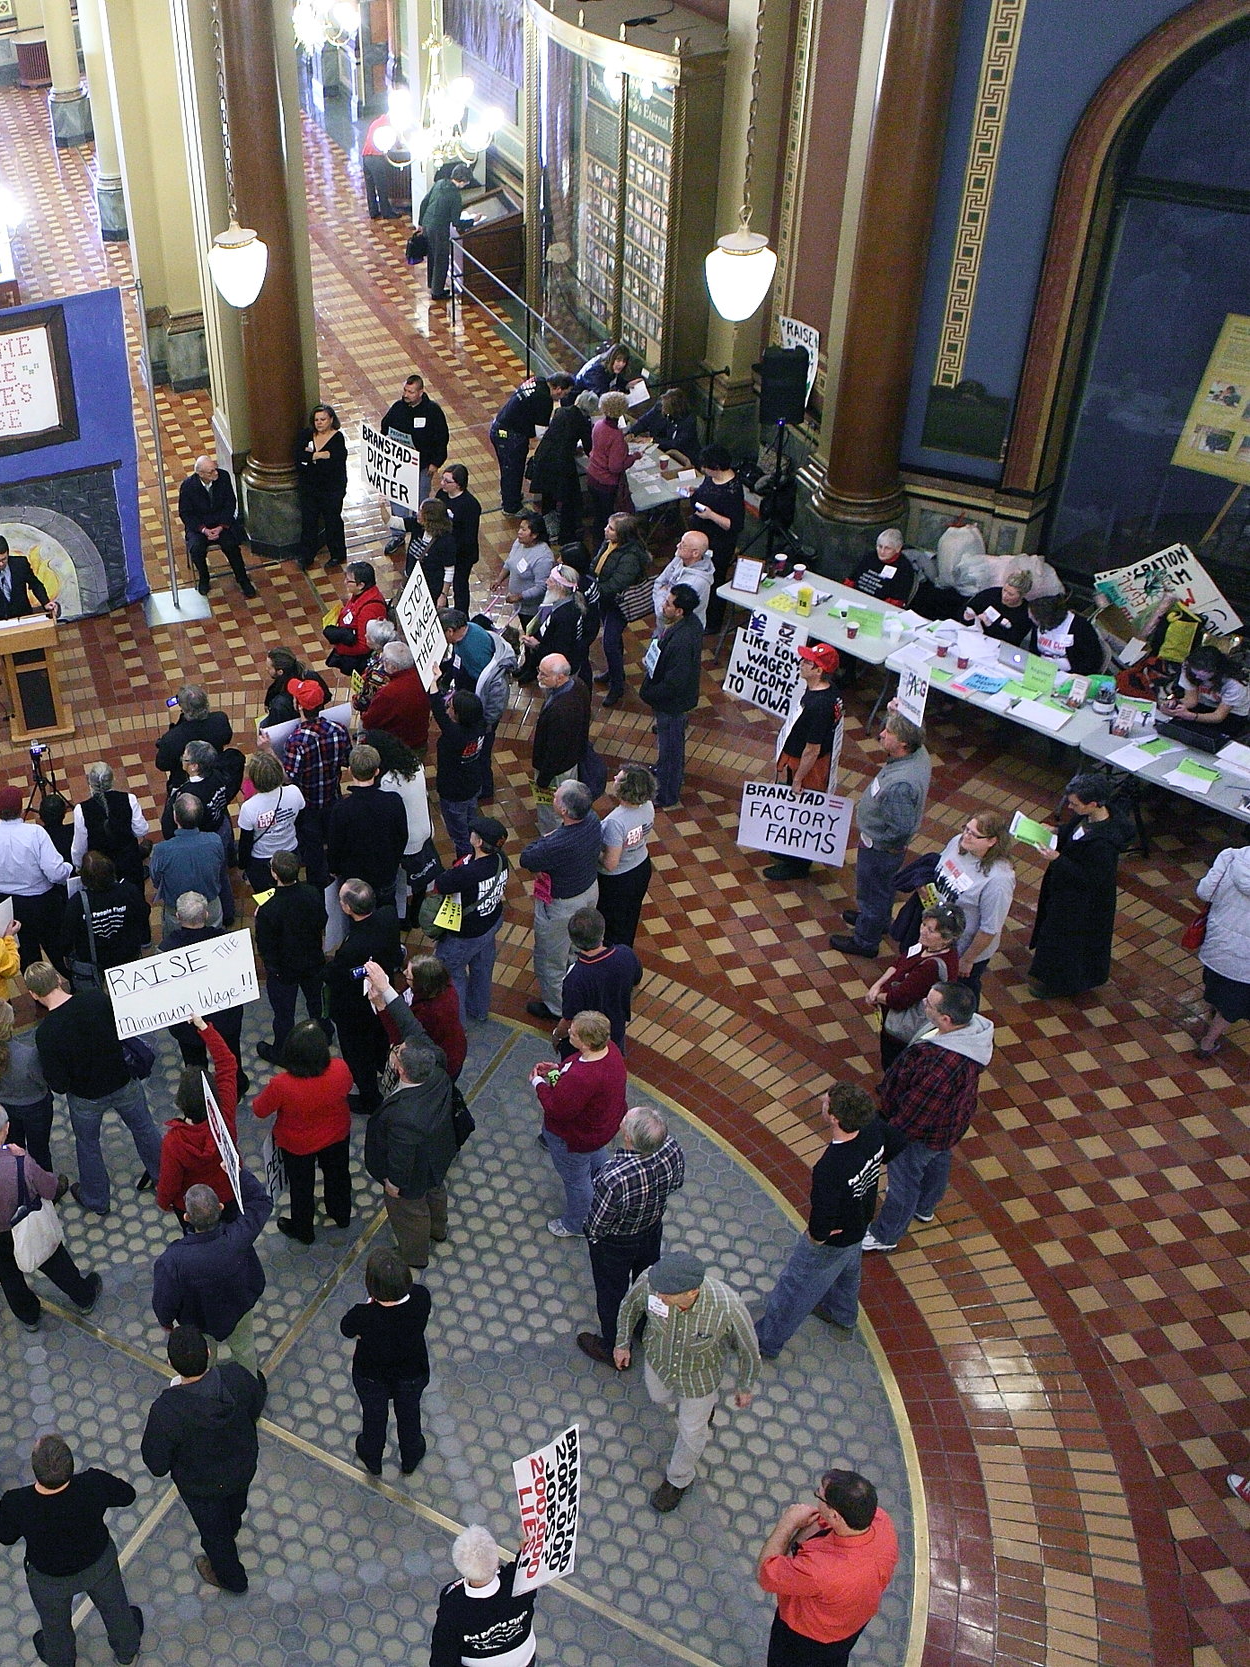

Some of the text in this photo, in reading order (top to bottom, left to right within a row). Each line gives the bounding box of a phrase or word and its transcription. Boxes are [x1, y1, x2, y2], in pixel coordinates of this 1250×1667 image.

[786, 321, 814, 348] RAISE
[367, 446, 402, 478] DIRTY
[365, 465, 409, 504] WATER
[403, 574, 423, 626] STOP
[410, 597, 434, 645] WAGE
[416, 615, 440, 671] THEFT
[742, 631, 804, 666] LIKE LOW
[729, 674, 790, 716] TO IOWA
[736, 660, 794, 699] WELCOME
[746, 784, 825, 806] BRANSTAD
[750, 801, 840, 831] FACTORY
[766, 823, 836, 854] FARMS
[108, 949, 208, 995] RAISE
[118, 1004, 194, 1034] Minimum
[559, 1429, 577, 1572] BRANSTAD
